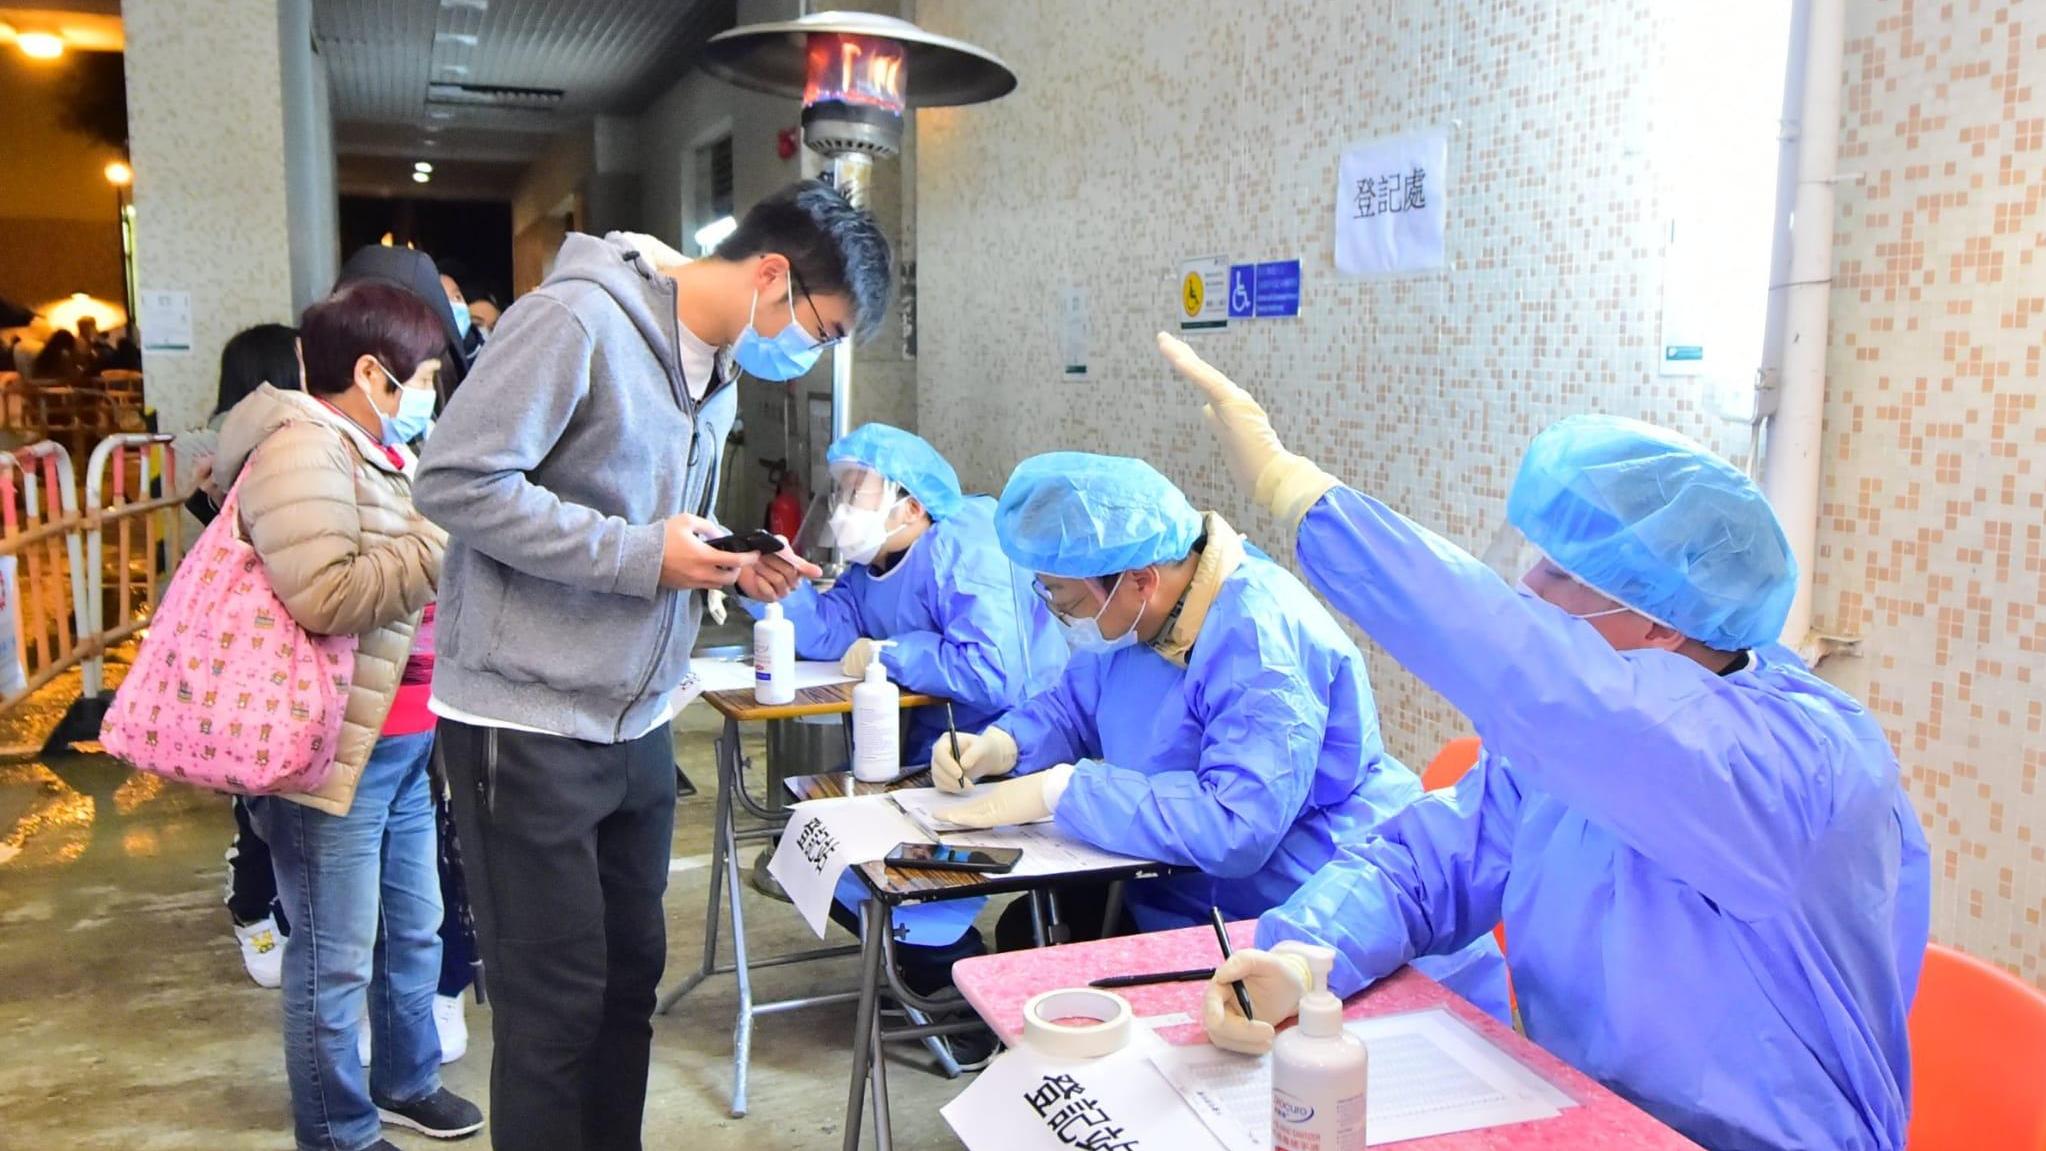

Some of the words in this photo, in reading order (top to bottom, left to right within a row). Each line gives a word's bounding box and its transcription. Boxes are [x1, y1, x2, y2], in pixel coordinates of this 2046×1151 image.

[1353, 166, 1426, 219] 登記處
[797, 817, 840, 875] 登記站
